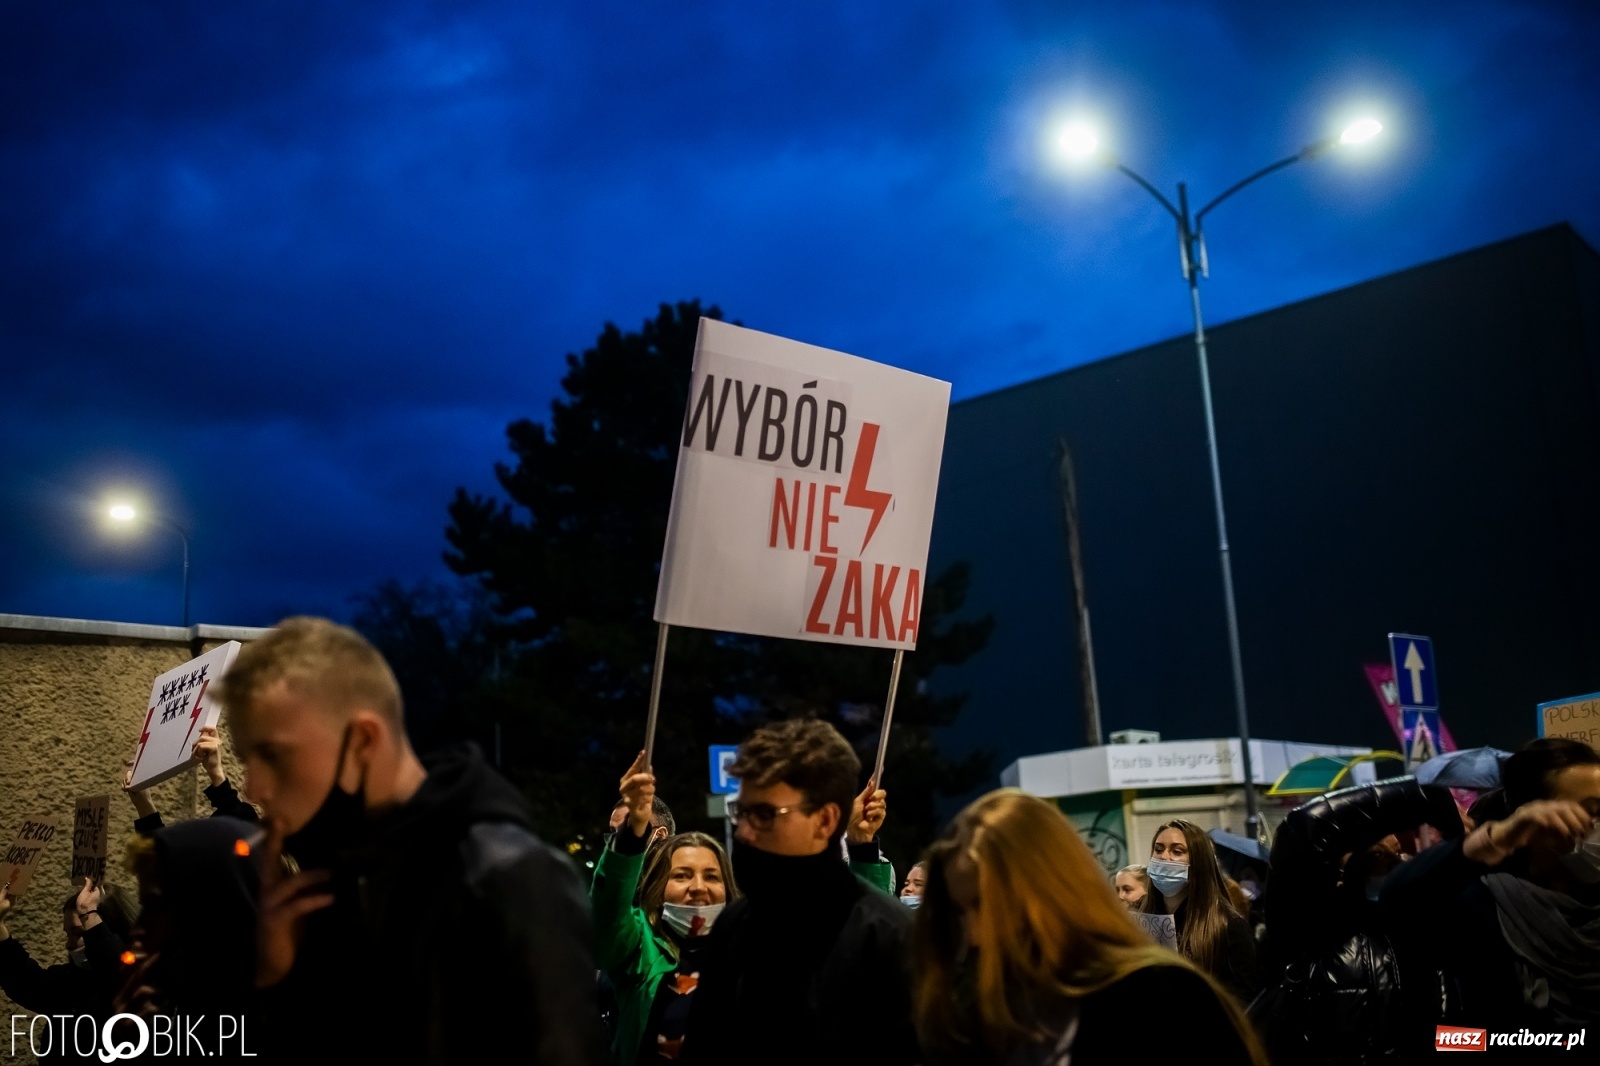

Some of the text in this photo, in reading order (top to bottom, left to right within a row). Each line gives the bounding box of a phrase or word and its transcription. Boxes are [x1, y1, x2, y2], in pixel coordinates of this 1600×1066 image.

[684, 374, 848, 474] WYBÓR
[768, 477, 842, 555] NIE
[805, 555, 920, 644] ZAKA
